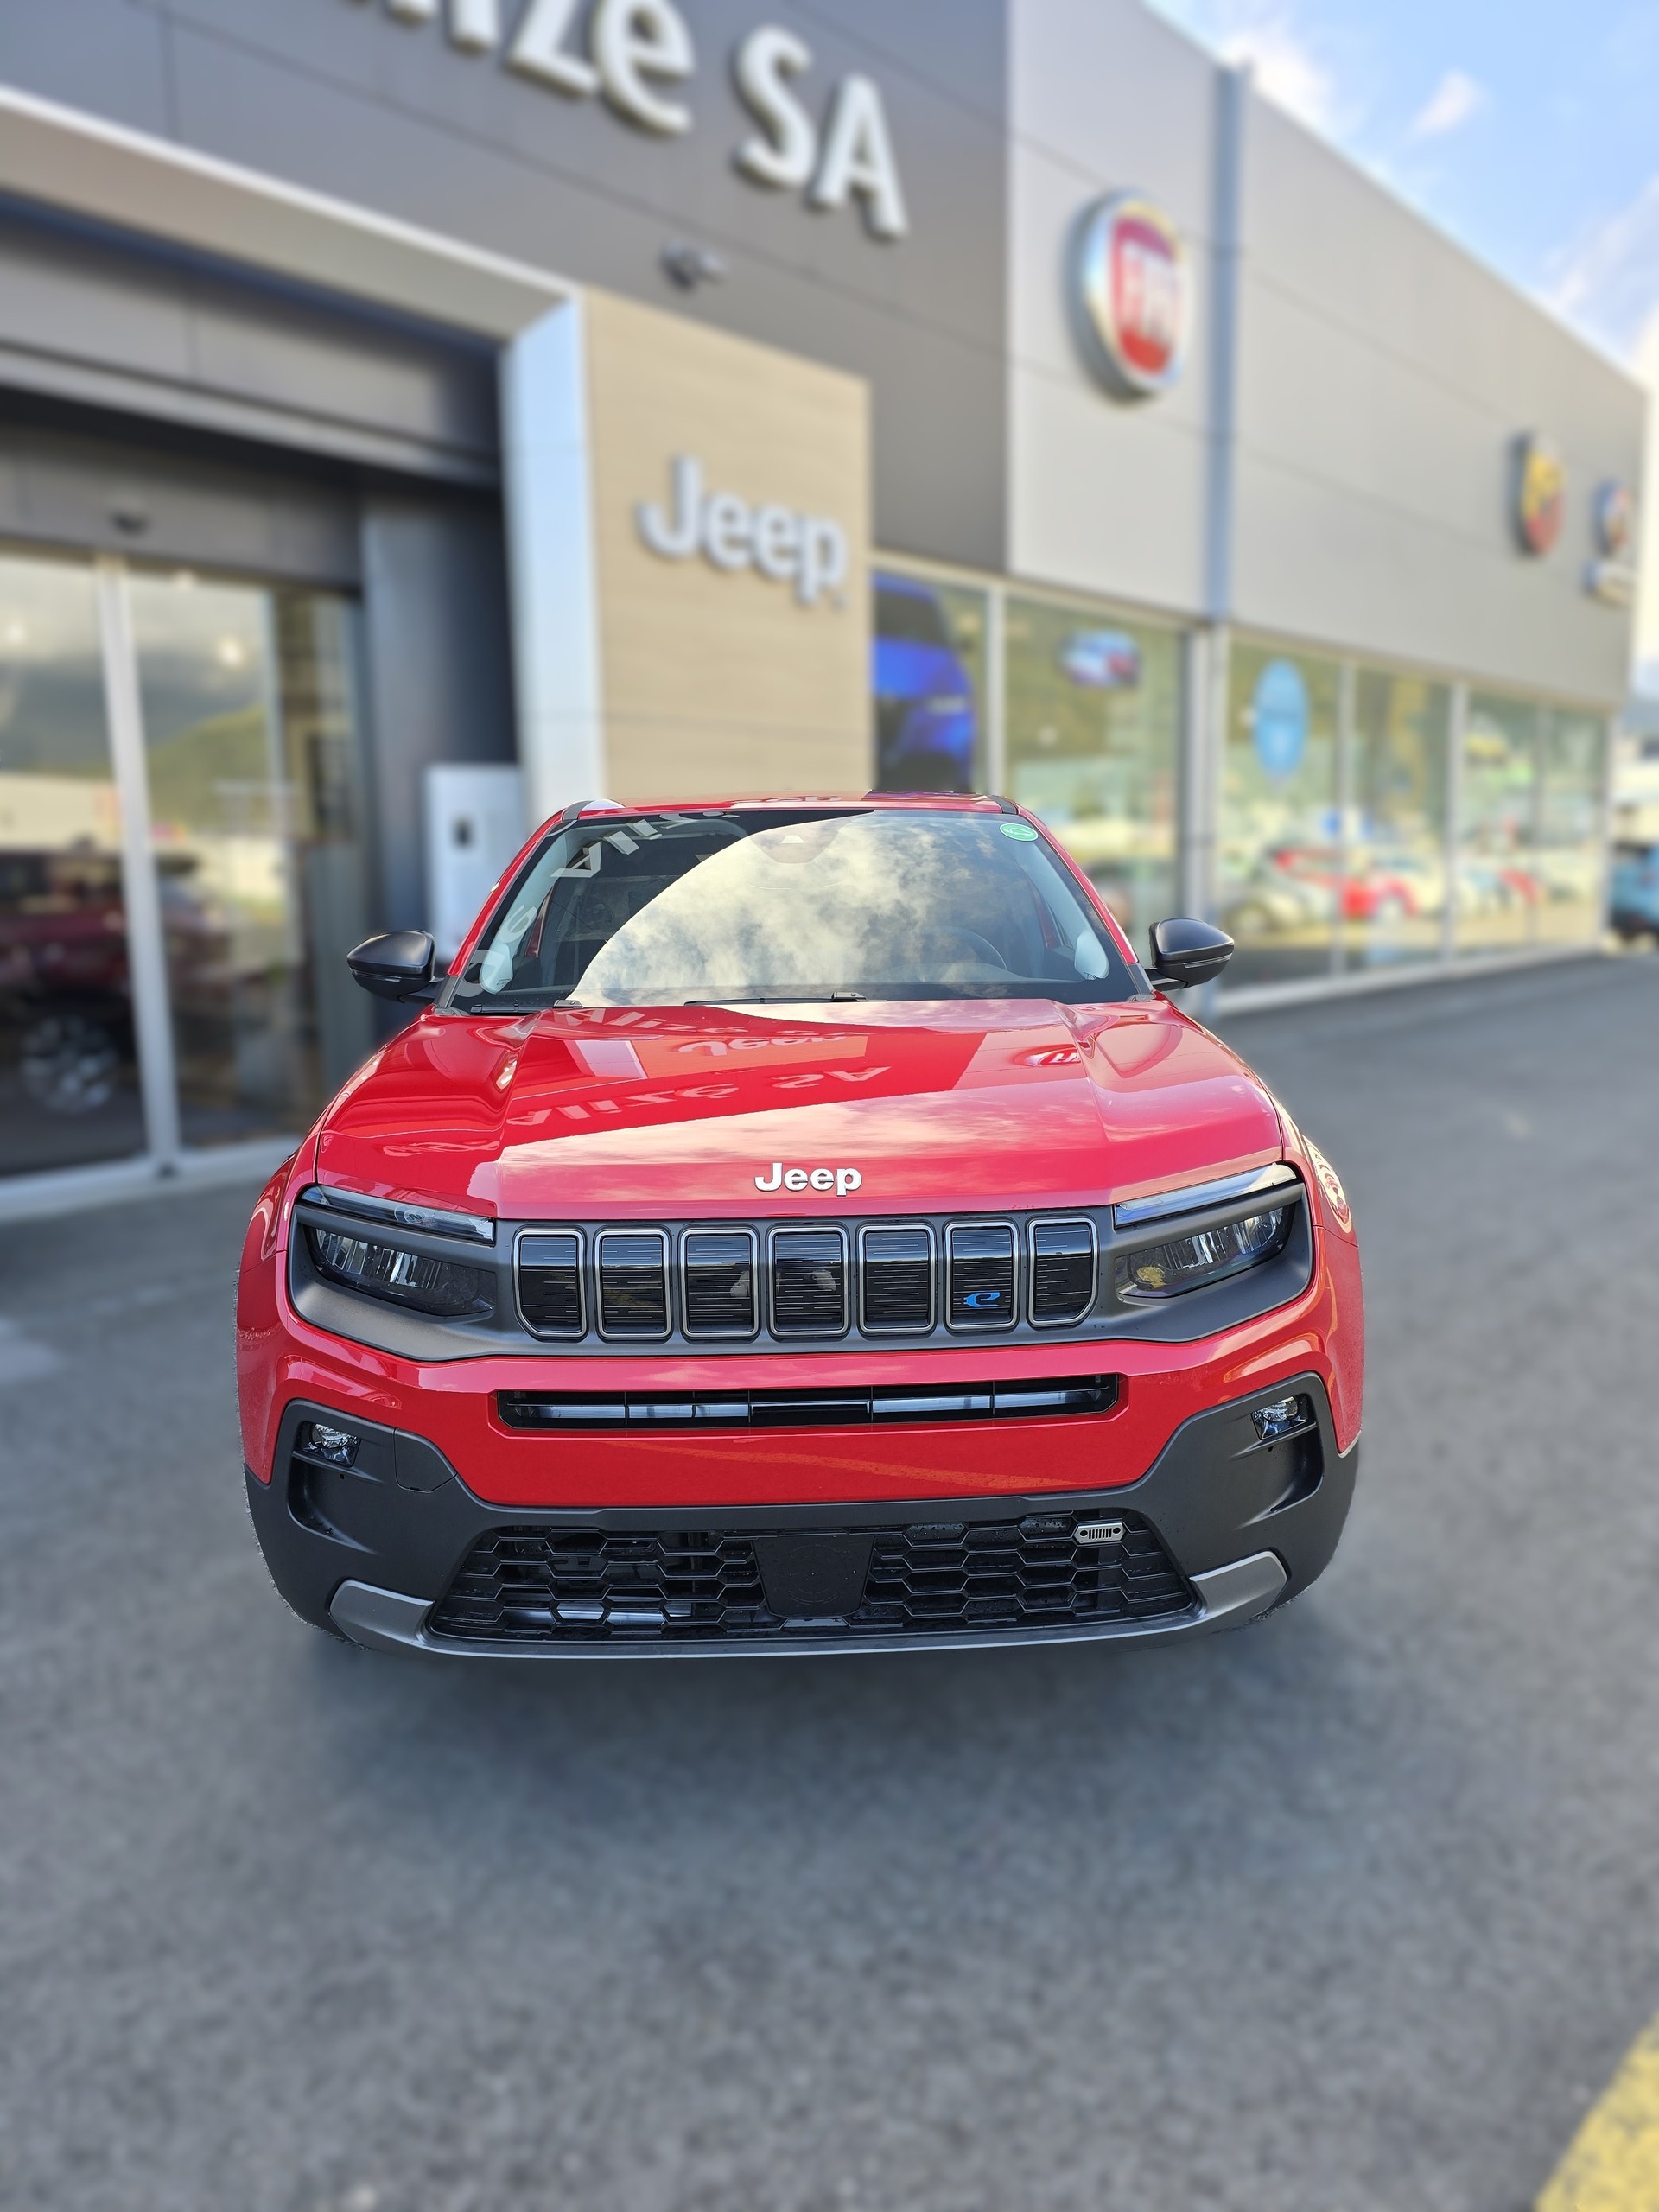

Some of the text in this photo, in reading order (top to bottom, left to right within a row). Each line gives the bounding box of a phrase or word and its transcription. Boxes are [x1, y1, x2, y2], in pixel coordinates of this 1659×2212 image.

[734, 24, 907, 238] SA
[635, 453, 848, 605] Jeep
[754, 1162, 862, 1197] Jeep
